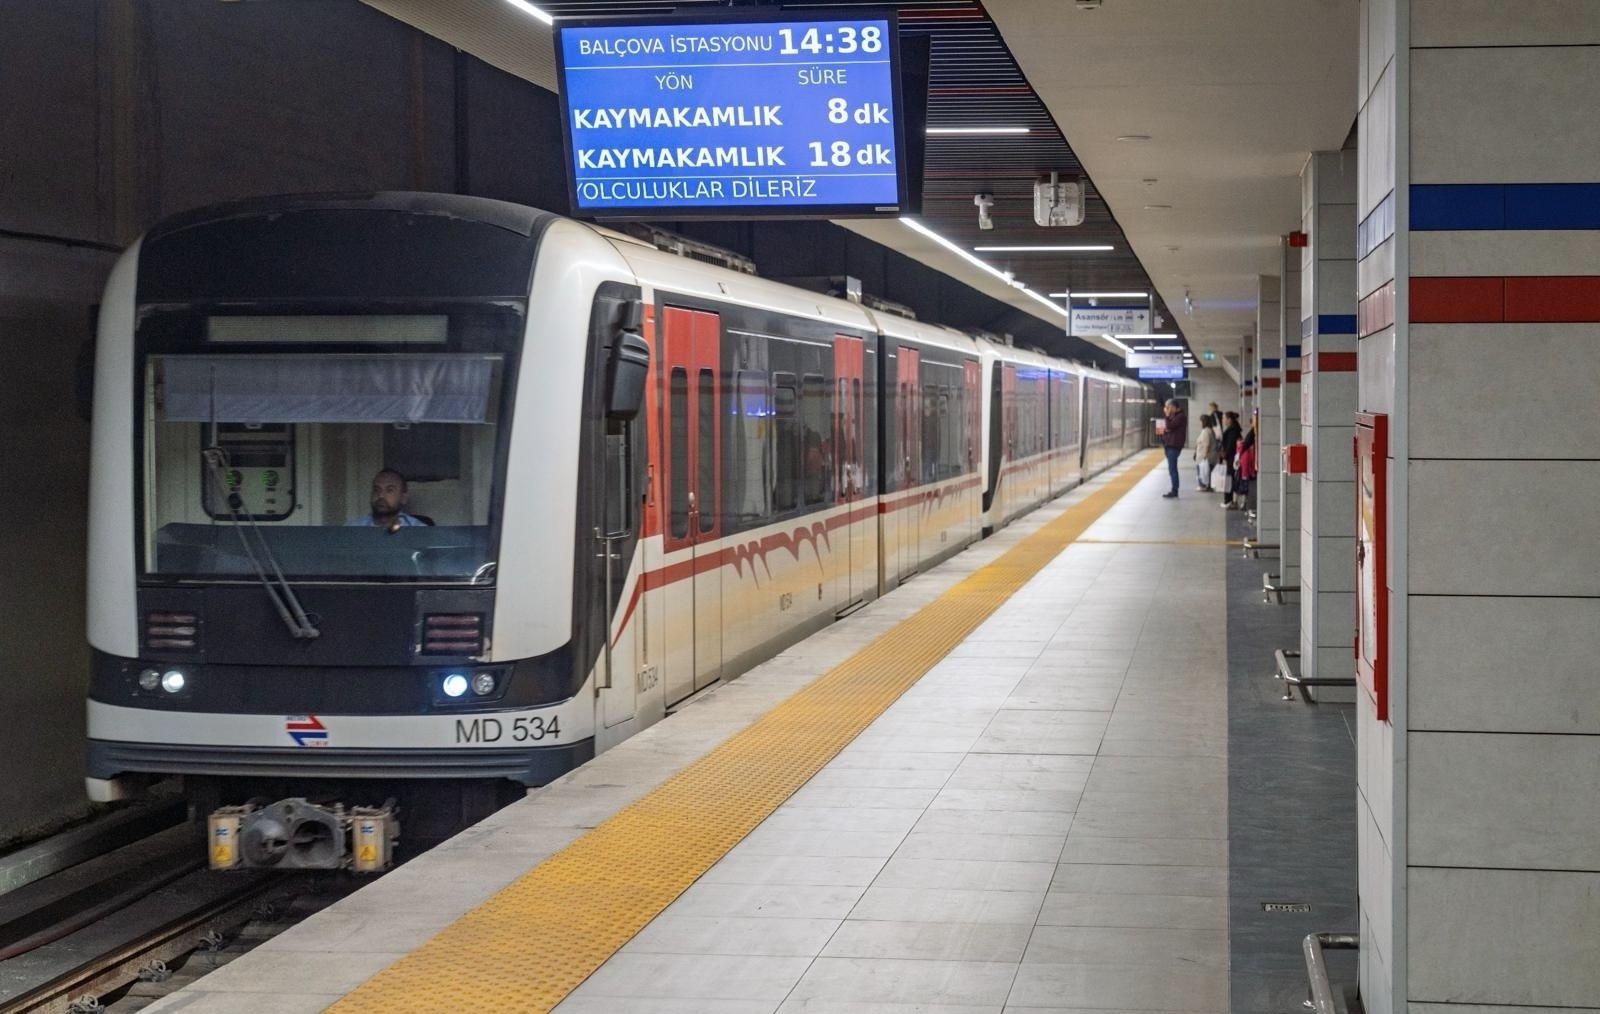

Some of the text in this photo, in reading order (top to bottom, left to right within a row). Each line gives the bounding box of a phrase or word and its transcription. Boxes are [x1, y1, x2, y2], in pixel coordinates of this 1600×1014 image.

[579, 34, 774, 58] BALÇOVA İSTASYONU
[778, 27, 882, 54] 14:38
[655, 72, 693, 90] YÖN
[798, 69, 848, 85] SÜRE
[574, 105, 784, 129] KAYMAKAMLIK
[827, 98, 890, 124] 8 dk
[578, 146, 786, 169] KAYMAKAMLIK
[808, 141, 892, 167] 18 dk
[733, 177, 817, 198] DİLERİZ
[456, 716, 561, 743] MD 534
